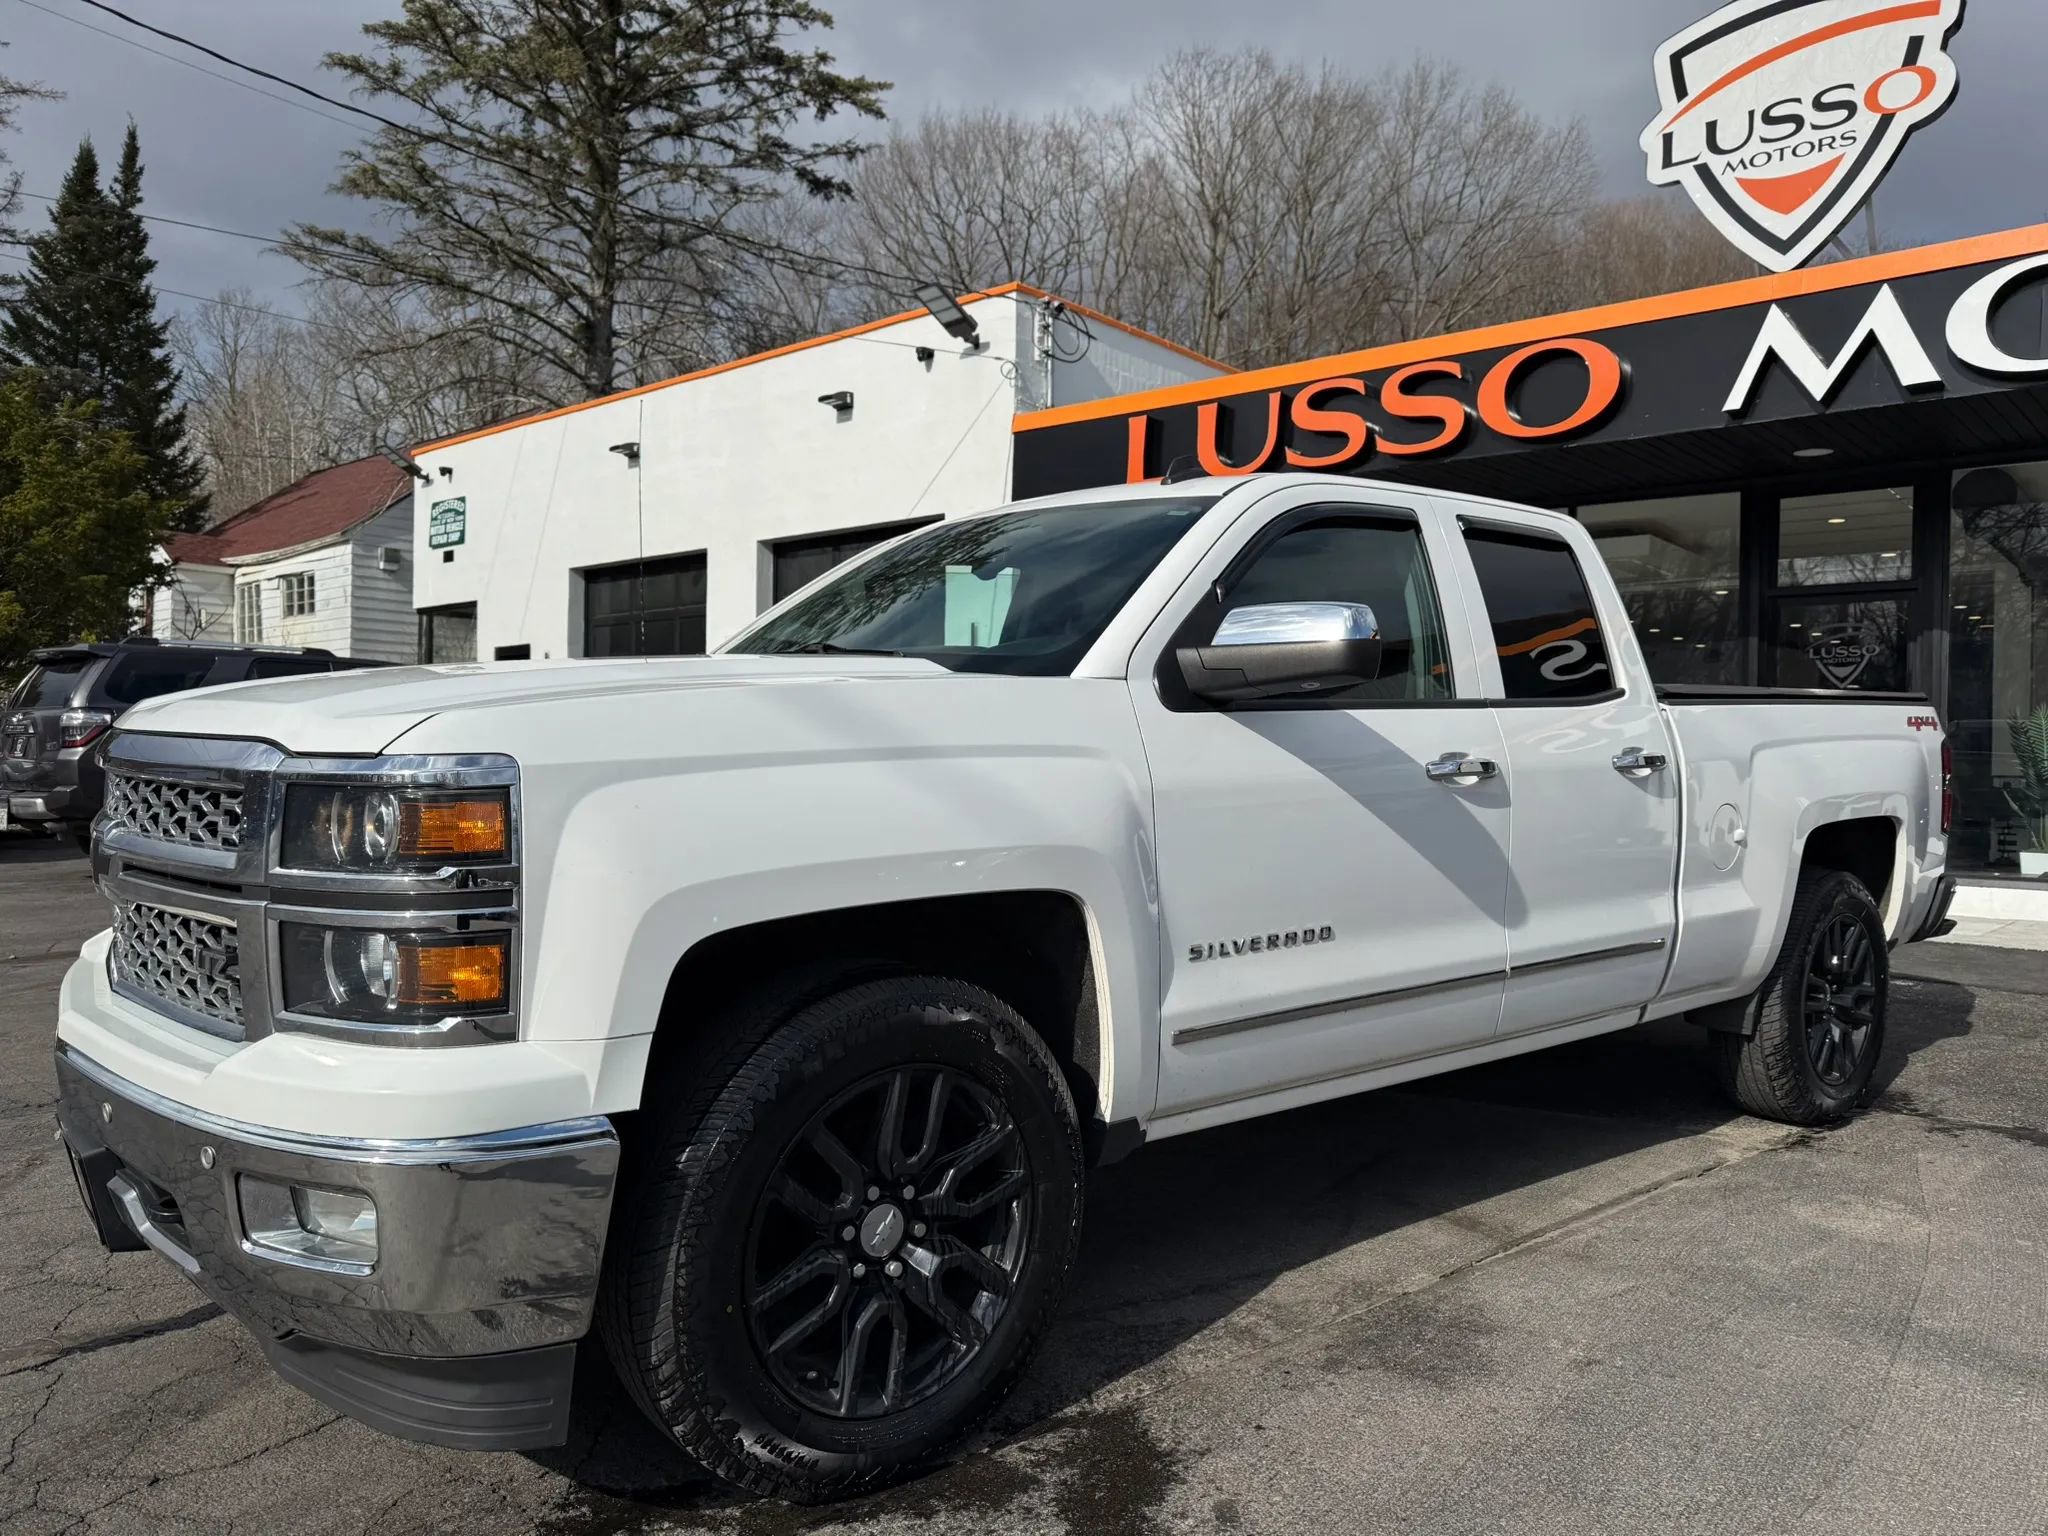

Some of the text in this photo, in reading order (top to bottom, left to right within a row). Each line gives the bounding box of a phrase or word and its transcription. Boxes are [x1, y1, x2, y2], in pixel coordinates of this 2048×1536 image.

[1661, 65, 1937, 170] LUSSO
[1721, 130, 1857, 175] MOTORS
[1809, 644, 1880, 659] LUSSO
[1189, 926, 1335, 962] SILVERADO
